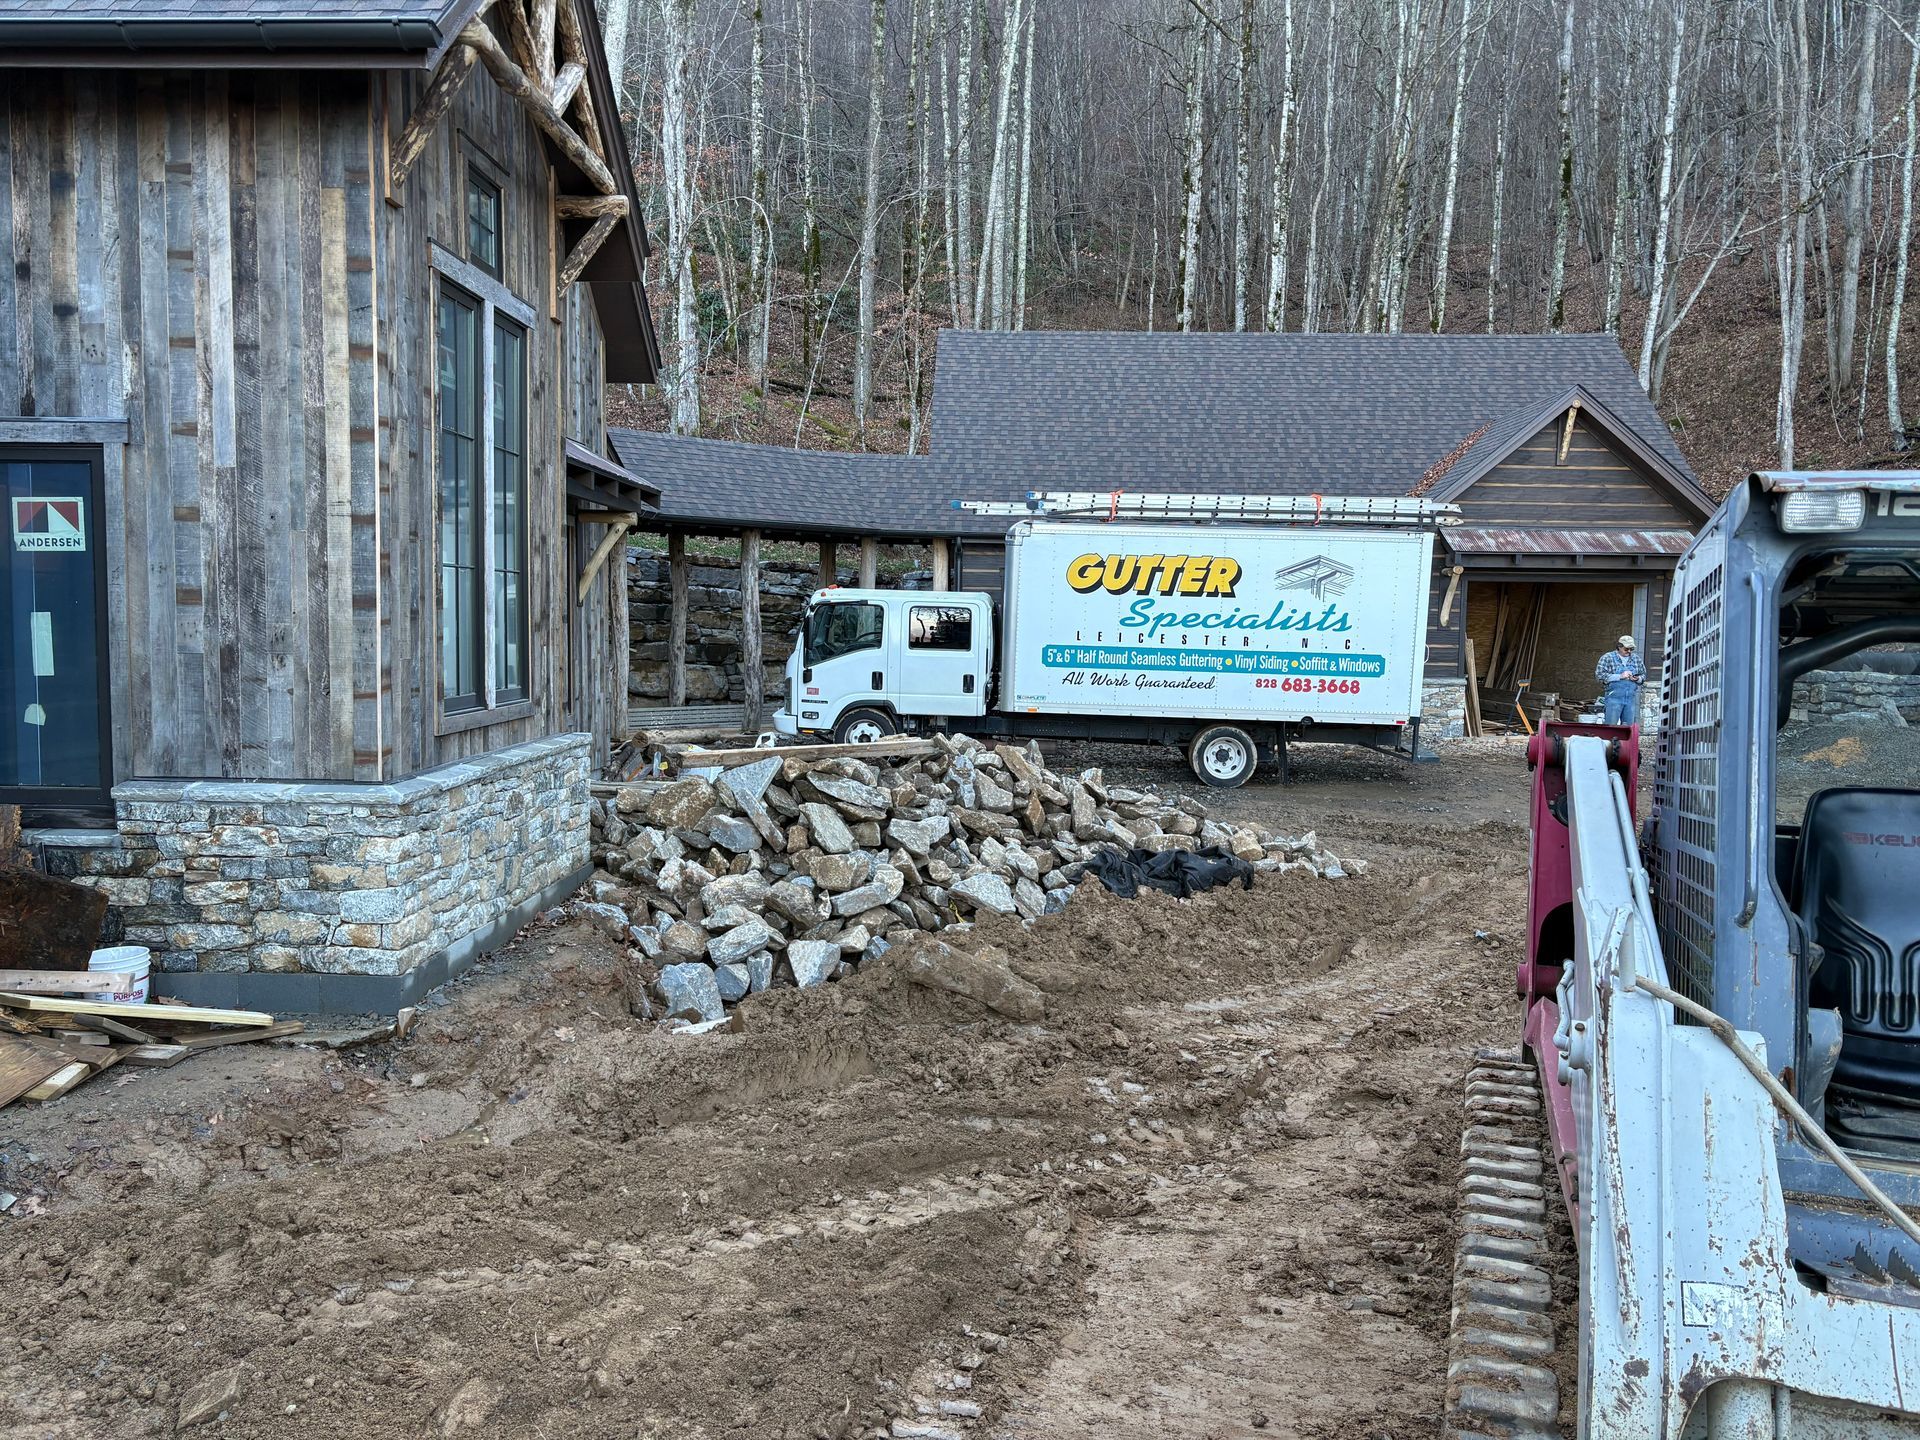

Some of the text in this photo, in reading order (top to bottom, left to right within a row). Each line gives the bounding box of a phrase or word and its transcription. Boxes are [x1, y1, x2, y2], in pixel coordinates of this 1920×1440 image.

[19, 537, 81, 547] ANDERSEN
[1066, 553, 1242, 598] GUTTER
[1119, 598, 1352, 638] Specialists
[1076, 630, 1269, 649] LEICESTER,
[1077, 649, 1097, 664] Half
[1098, 650, 1128, 665] Round
[1130, 651, 1176, 666] Seamless
[1179, 652, 1223, 670] Guttering
[1234, 654, 1257, 671] Vinyl
[1259, 655, 1289, 672] Siding
[1300, 656, 1328, 671] Soffitt
[1329, 661, 1337, 671] &
[1338, 657, 1380, 673] Windows
[1062, 671, 1216, 691] All Work Guaranteed
[1255, 677, 1360, 694] 828 683-3668
[113, 988, 144, 1001] PURPOSE
